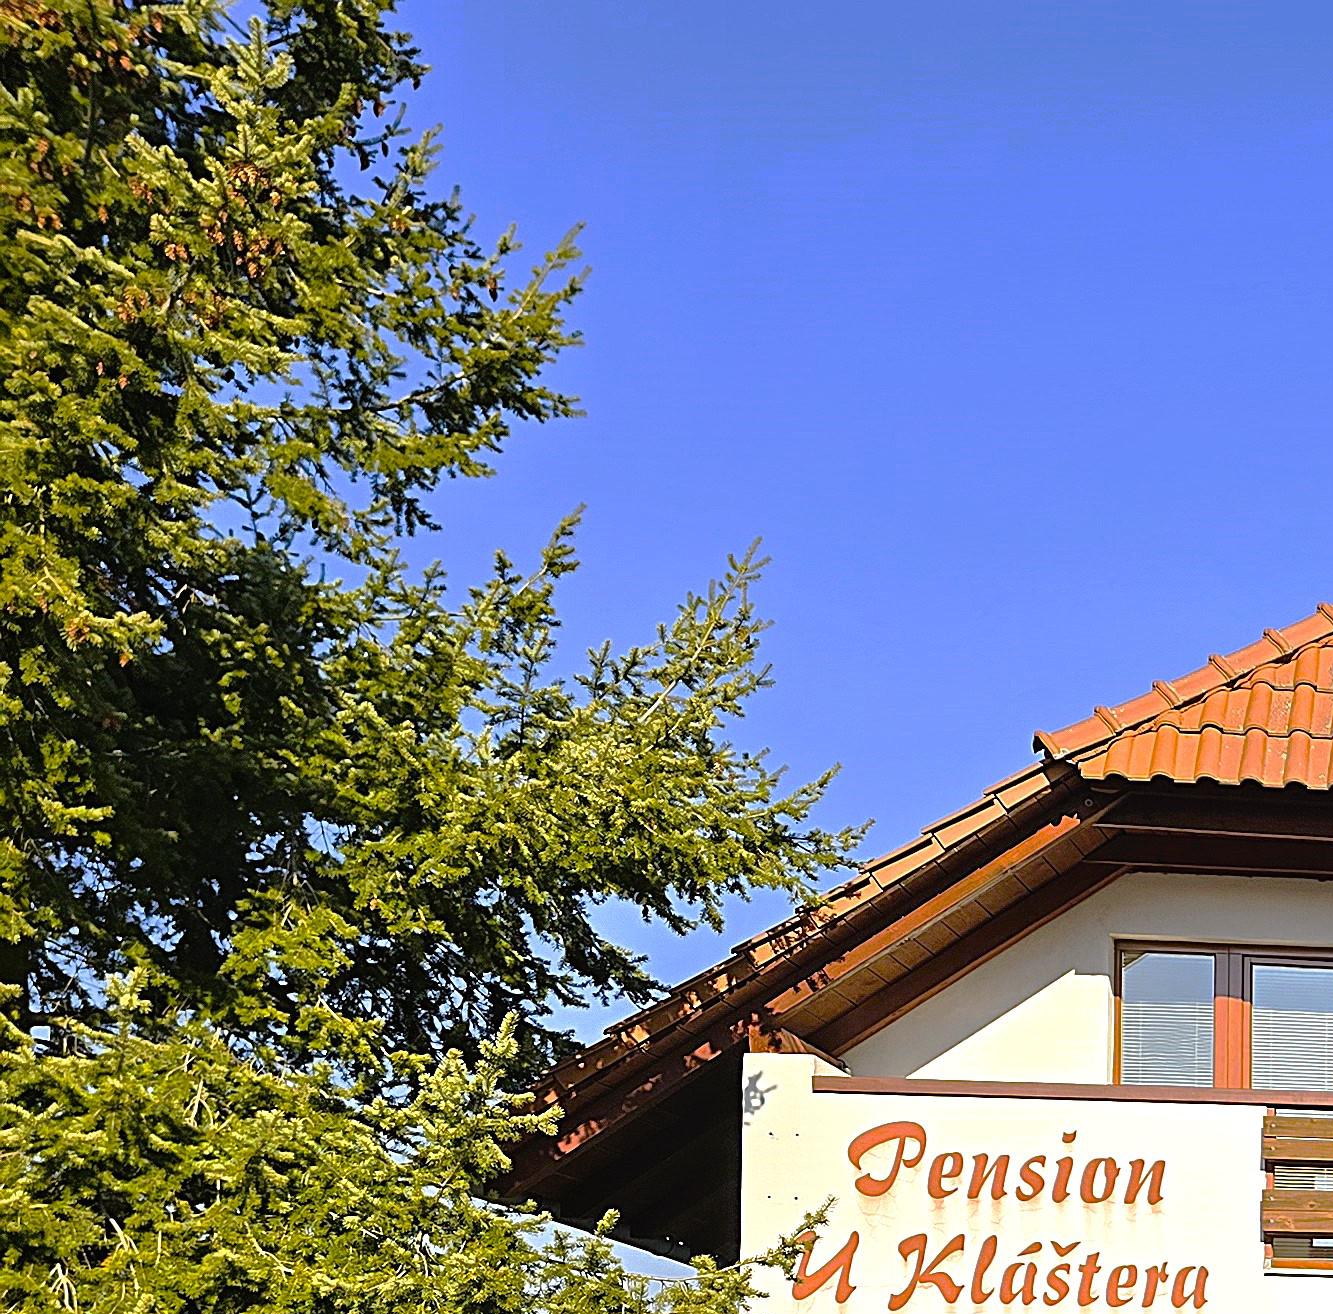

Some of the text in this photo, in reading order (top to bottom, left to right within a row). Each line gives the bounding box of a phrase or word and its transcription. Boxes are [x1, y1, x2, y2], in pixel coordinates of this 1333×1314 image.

[847, 1120, 1167, 1206] Pension
[791, 1230, 1210, 1312] U Kláštera
